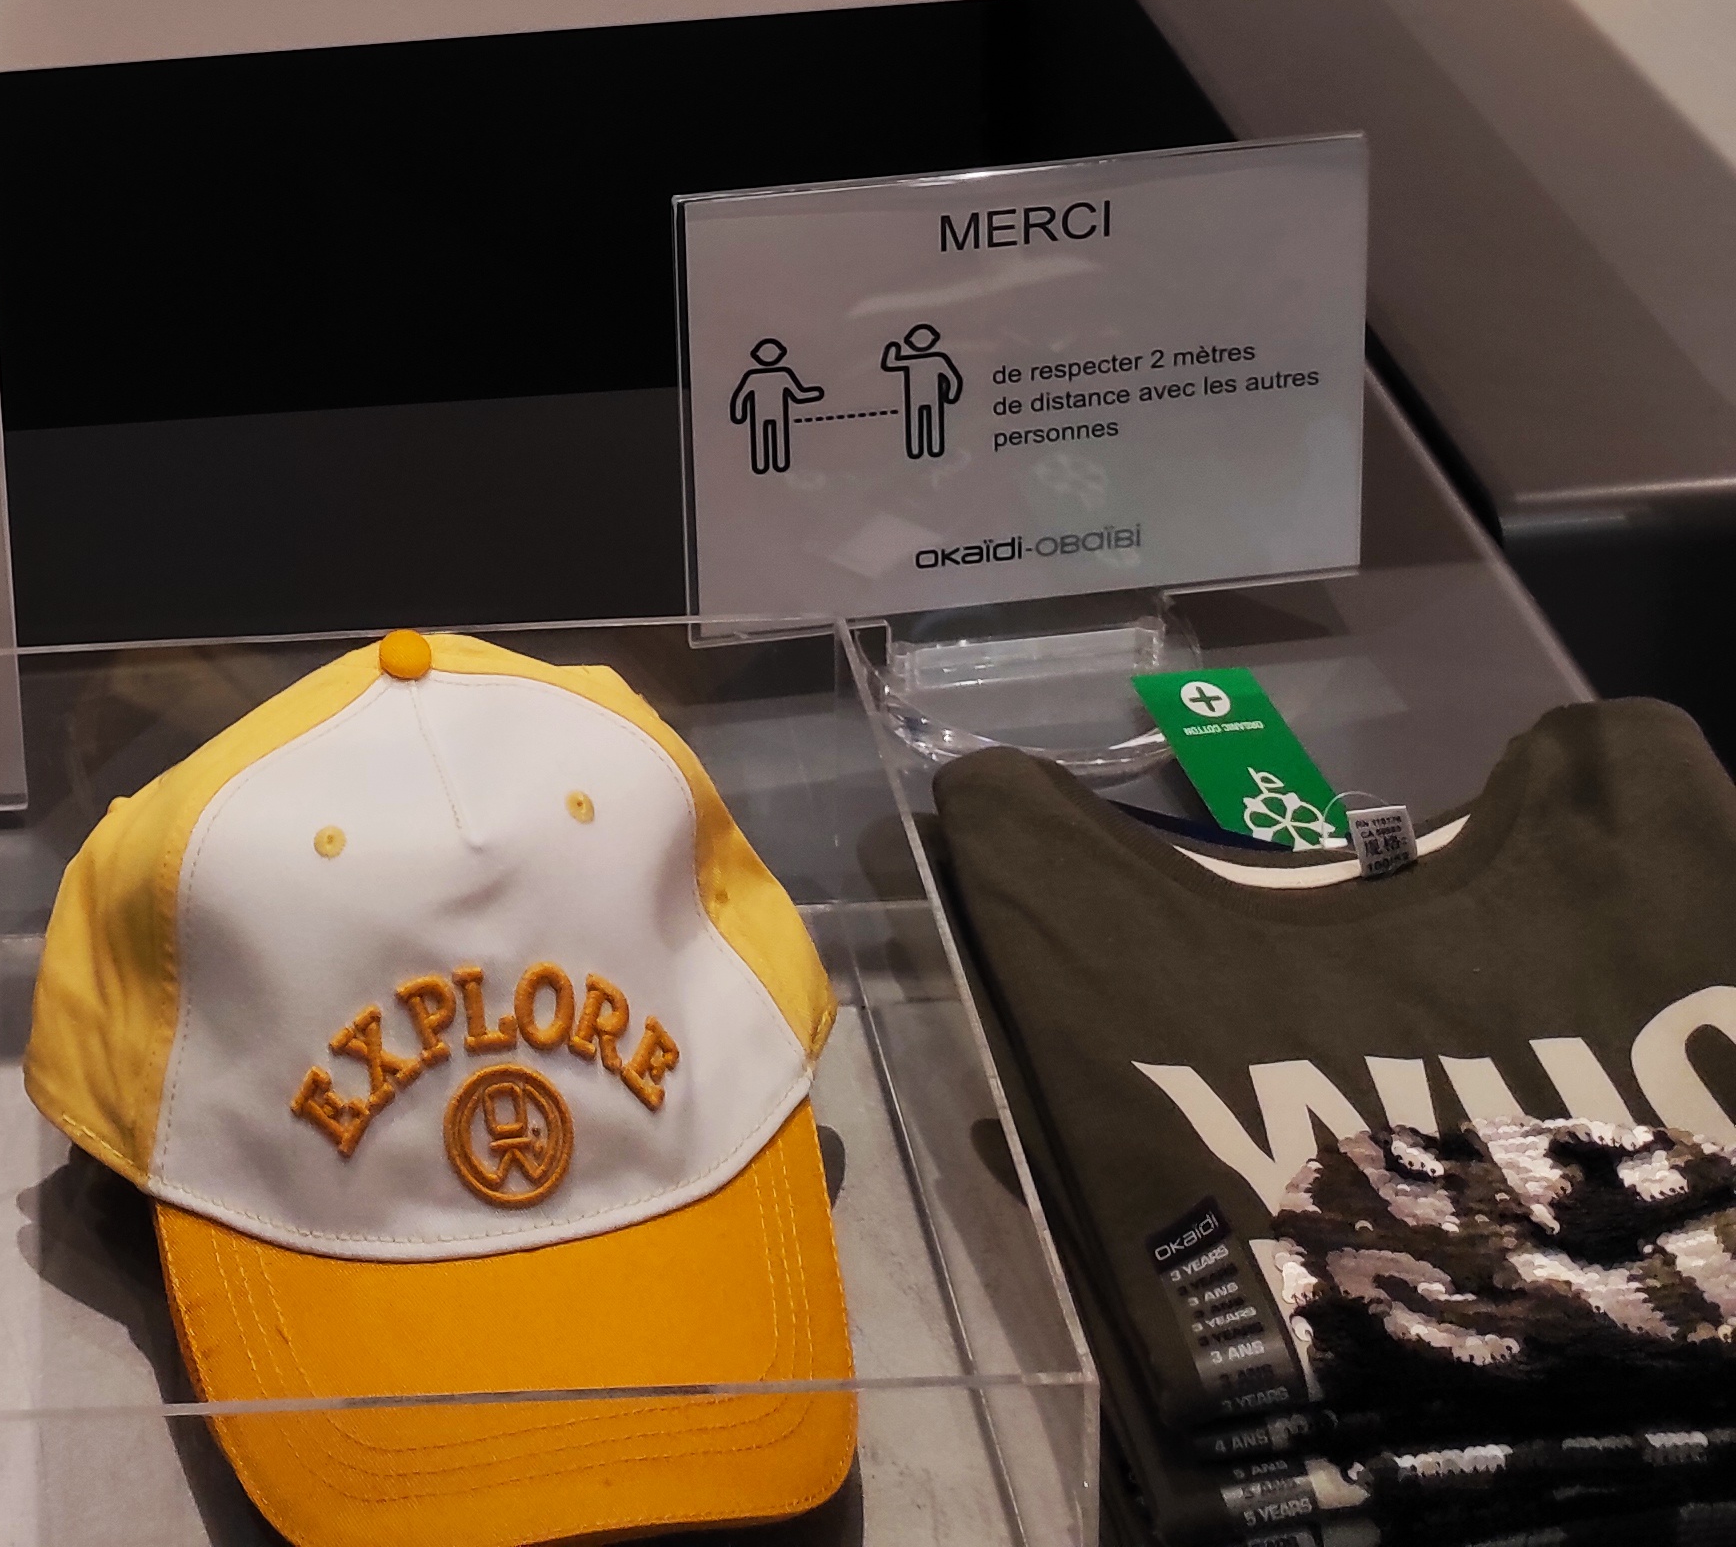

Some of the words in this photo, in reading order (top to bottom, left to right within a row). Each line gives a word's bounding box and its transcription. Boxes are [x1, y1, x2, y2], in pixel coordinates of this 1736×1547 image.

[939, 199, 1113, 253] MERCI
[992, 364, 1023, 385] de
[1029, 353, 1143, 382] respecter
[1149, 349, 1166, 370] 2
[1172, 341, 1257, 369] mètres
[992, 395, 1024, 416] de
[1030, 386, 1131, 414] distance
[1138, 381, 1197, 403] avec
[1202, 375, 1238, 397] les
[1244, 368, 1321, 393] autres
[992, 419, 1121, 453] personnes
[289, 961, 682, 1158] EXPLORE
[1169, 1270, 1182, 1283] 3
[1182, 1243, 1230, 1275] YEARS
[1187, 1296, 1200, 1308] 3
[1203, 1281, 1240, 1303] ANS
[1205, 1306, 1258, 1329] YEARS
[1210, 1350, 1223, 1365] 3
[1227, 1339, 1266, 1362] ANS
[1215, 1438, 1227, 1454] 4
[1231, 1428, 1269, 1452] ANS
[1243, 1509, 1257, 1527] 5
[1258, 1497, 1313, 1523] YEARS
